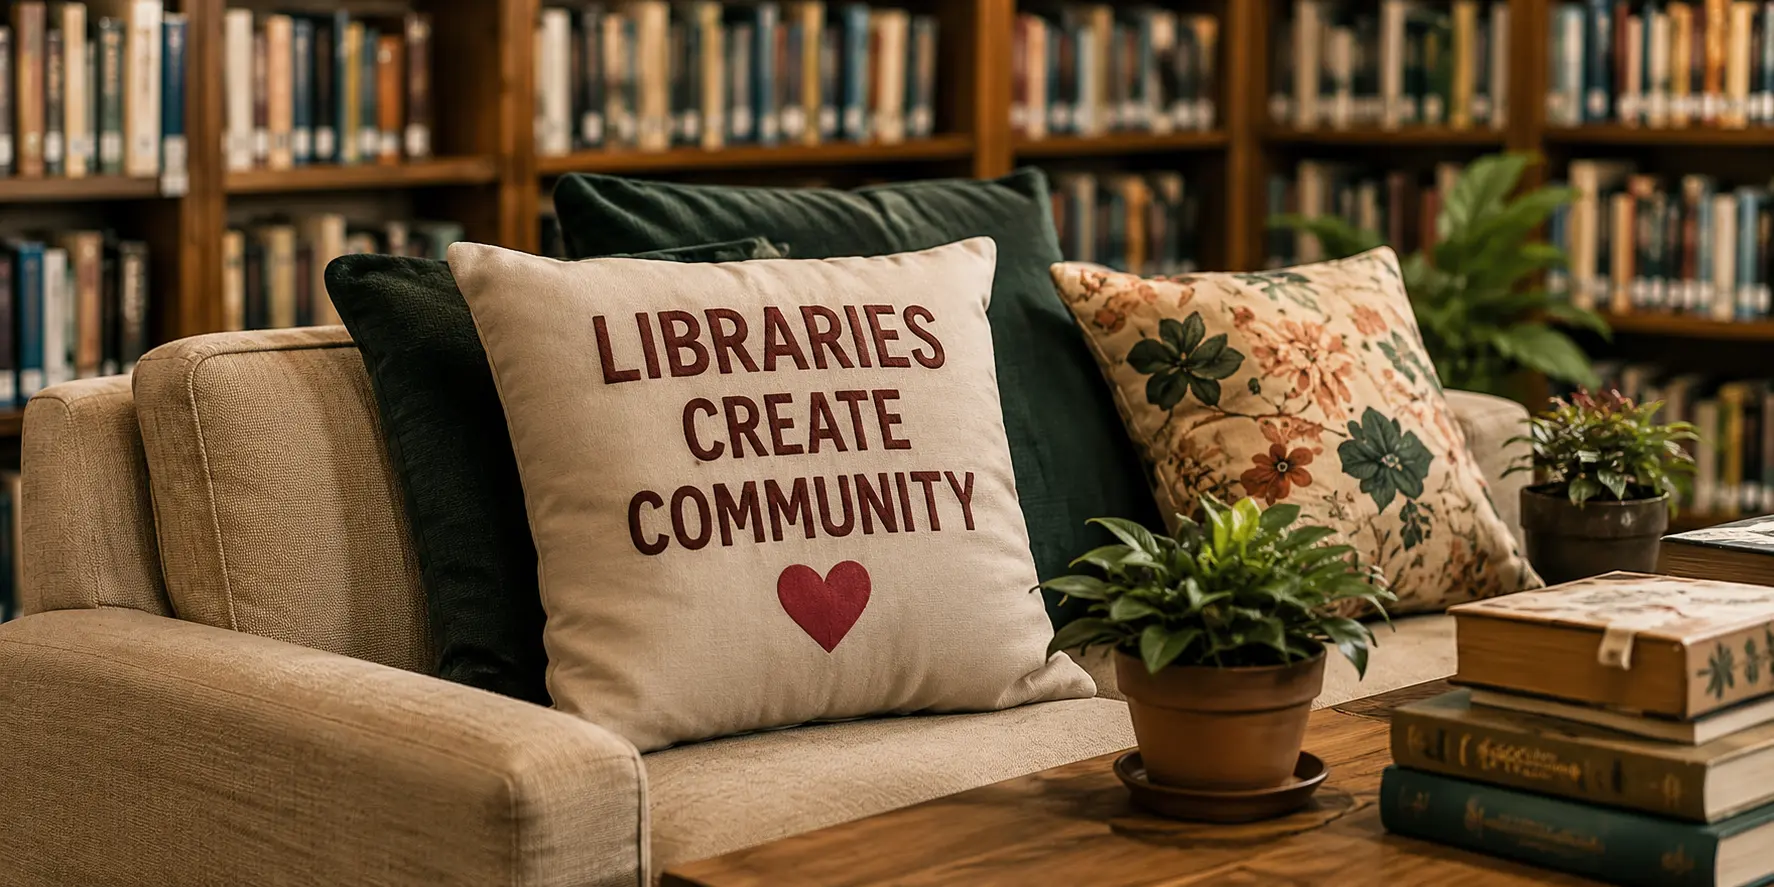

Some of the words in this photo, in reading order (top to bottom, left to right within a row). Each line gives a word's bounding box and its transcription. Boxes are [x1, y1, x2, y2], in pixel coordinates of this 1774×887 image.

[592, 304, 946, 385] LIBRARIES
[682, 388, 912, 462] CREATE
[627, 470, 975, 556] COMMUNITY
